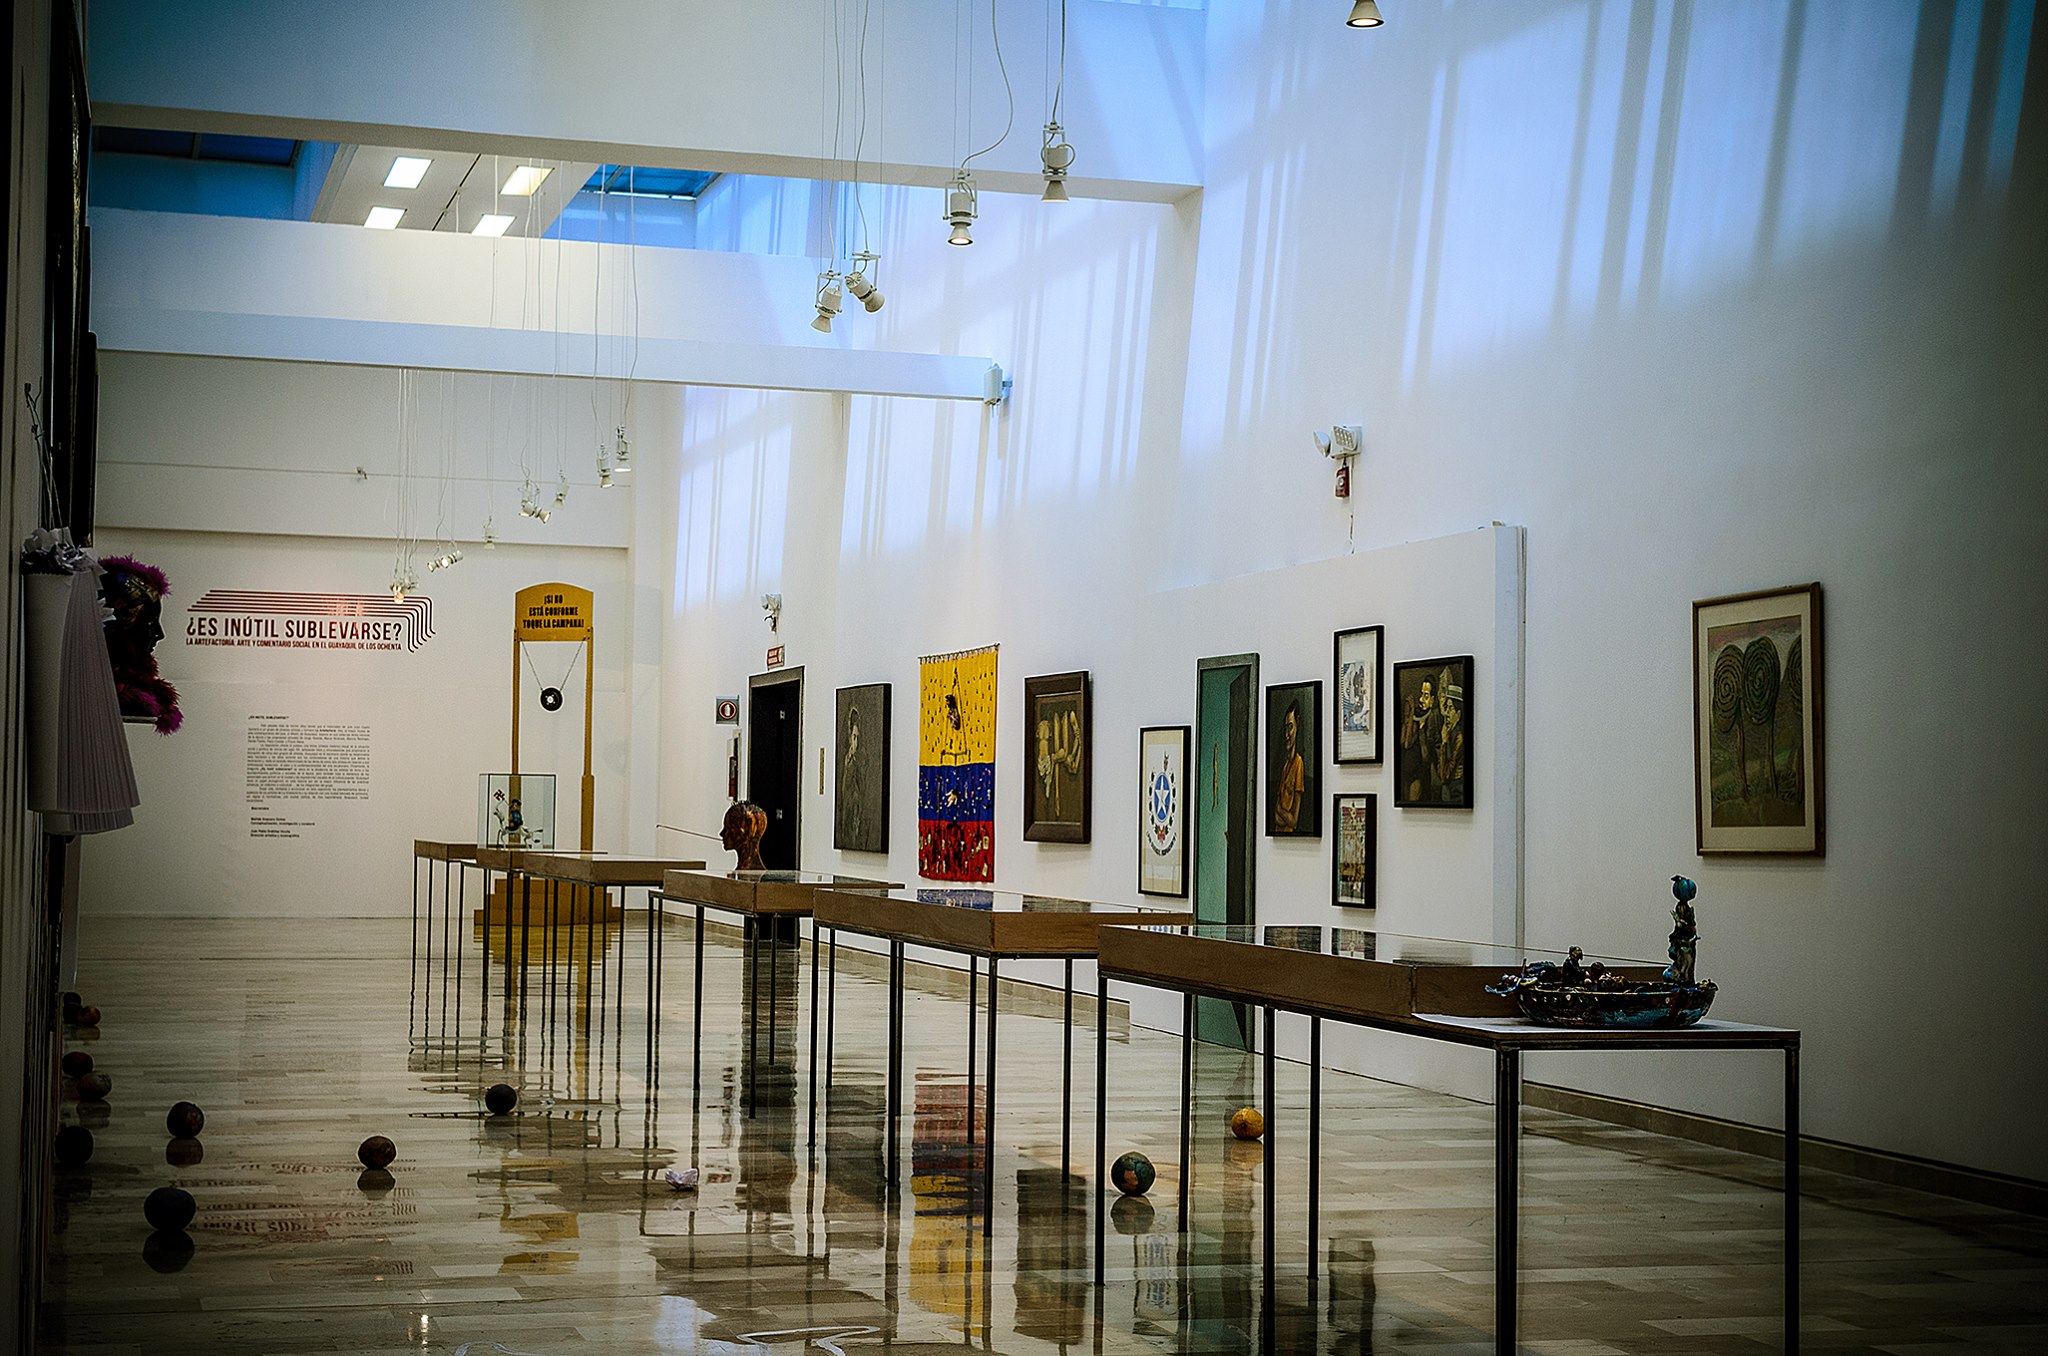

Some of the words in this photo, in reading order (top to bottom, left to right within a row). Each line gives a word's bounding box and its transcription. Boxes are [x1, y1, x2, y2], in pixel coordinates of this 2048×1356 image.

[545, 607, 578, 616] CONFORME
[187, 617, 217, 636] ¿ES
[225, 616, 279, 637] INÚTIL
[285, 619, 402, 640] SUBLEVARSE?
[523, 619, 542, 629] TOQUE
[543, 619, 551, 628] LA
[186, 638, 193, 646] LA
[292, 640, 311, 648] SOCIAL
[328, 641, 357, 649] GUAYAQUIL
[366, 642, 376, 650] LOS
[377, 642, 402, 650] OCHENTA
